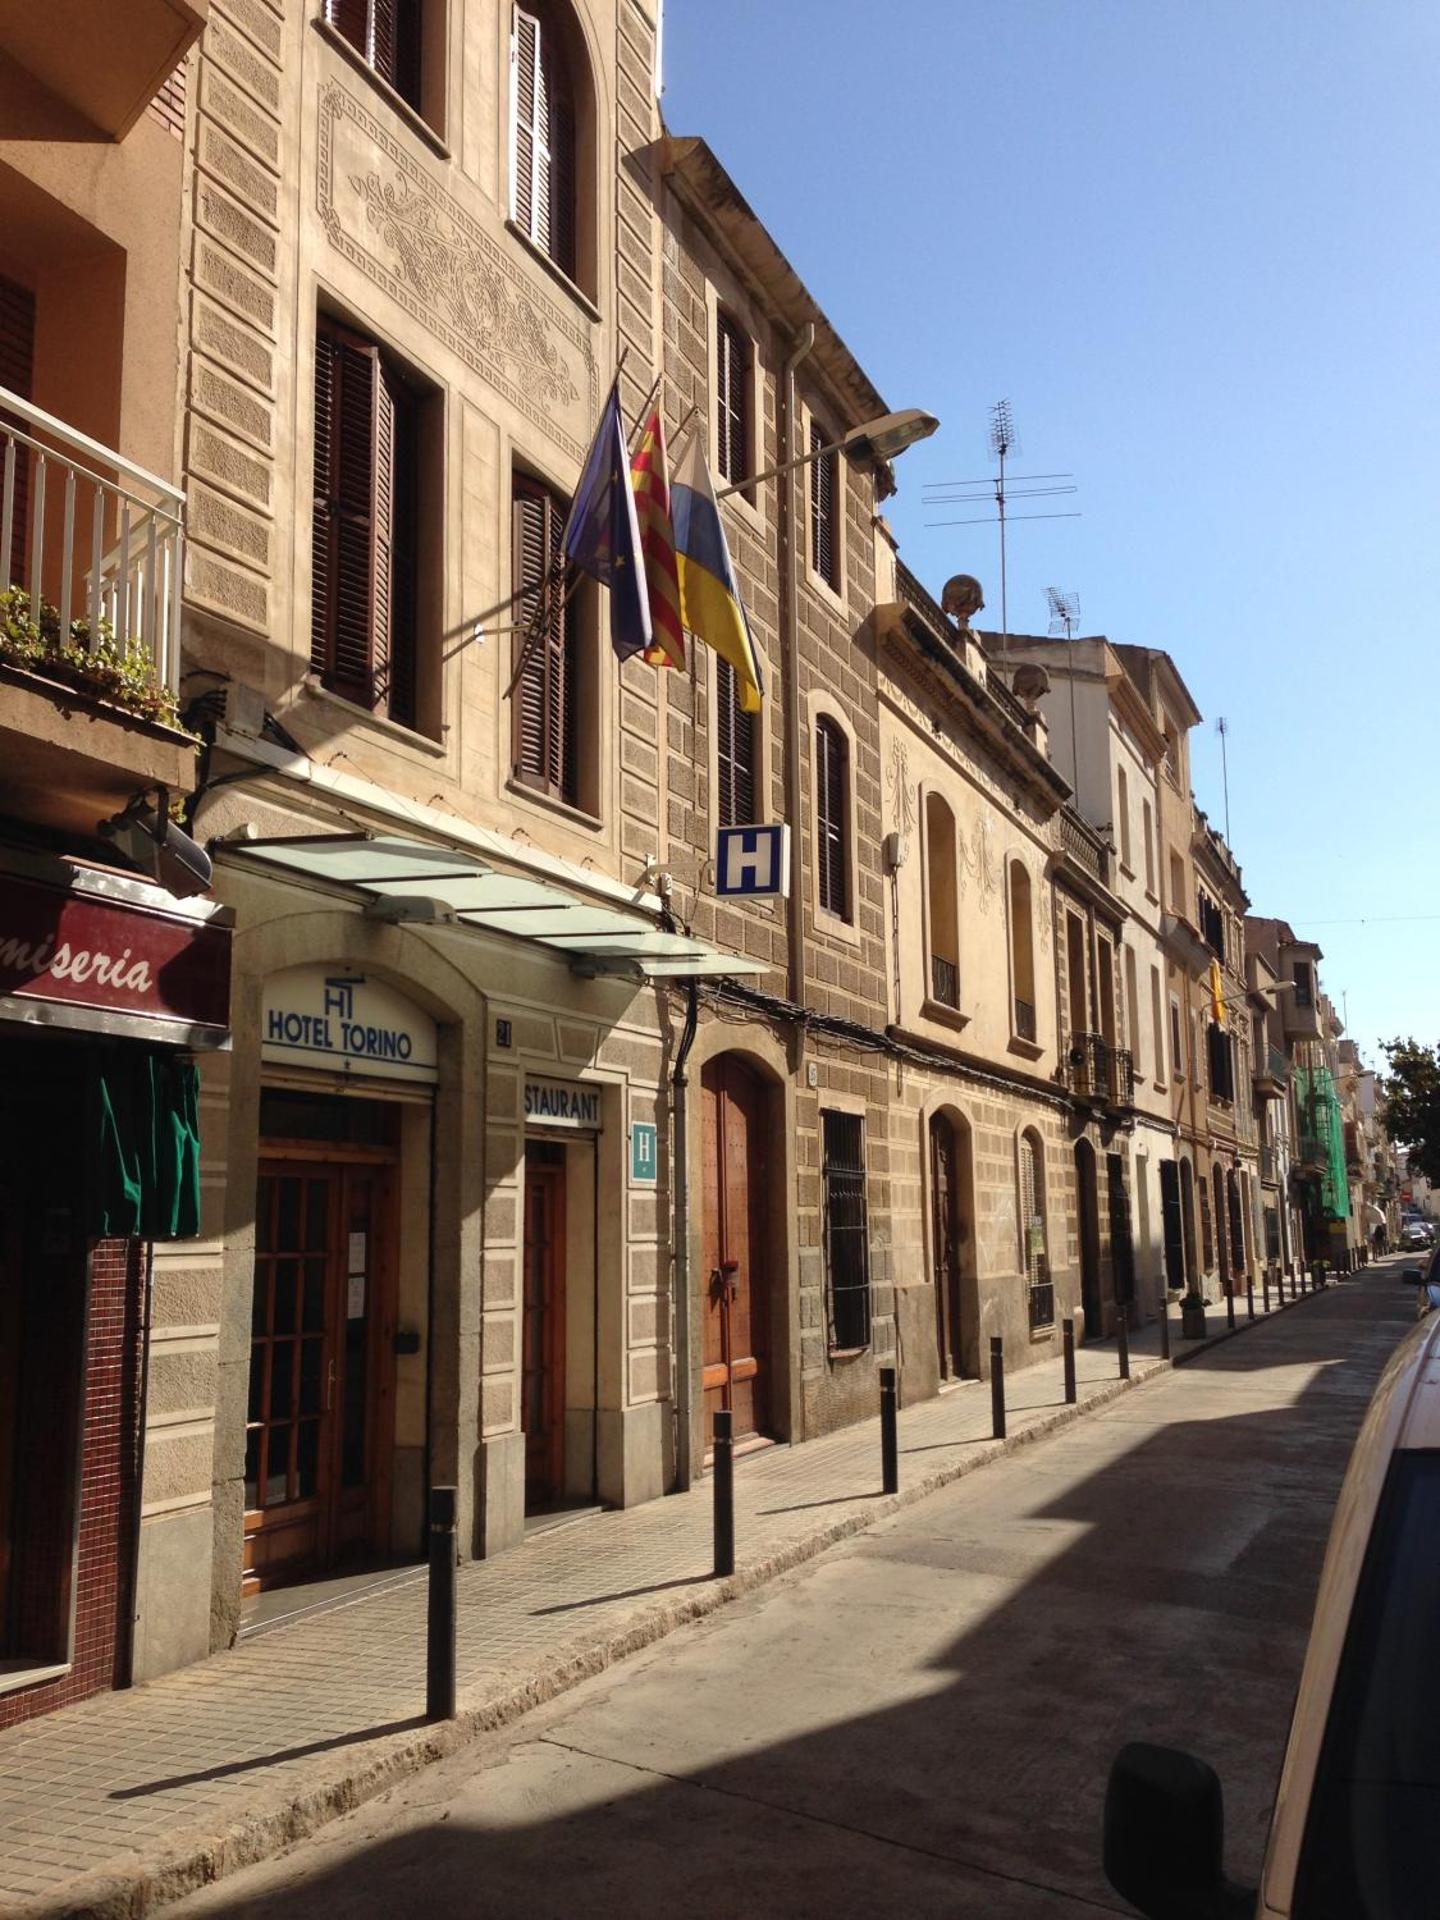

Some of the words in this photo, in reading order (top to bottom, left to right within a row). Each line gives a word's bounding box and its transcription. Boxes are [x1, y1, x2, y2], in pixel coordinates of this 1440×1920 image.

[726, 832, 772, 890] H
[268, 1009, 333, 1048] HOTEL
[341, 1021, 412, 1060] TORINO
[638, 1131, 651, 1162] H
